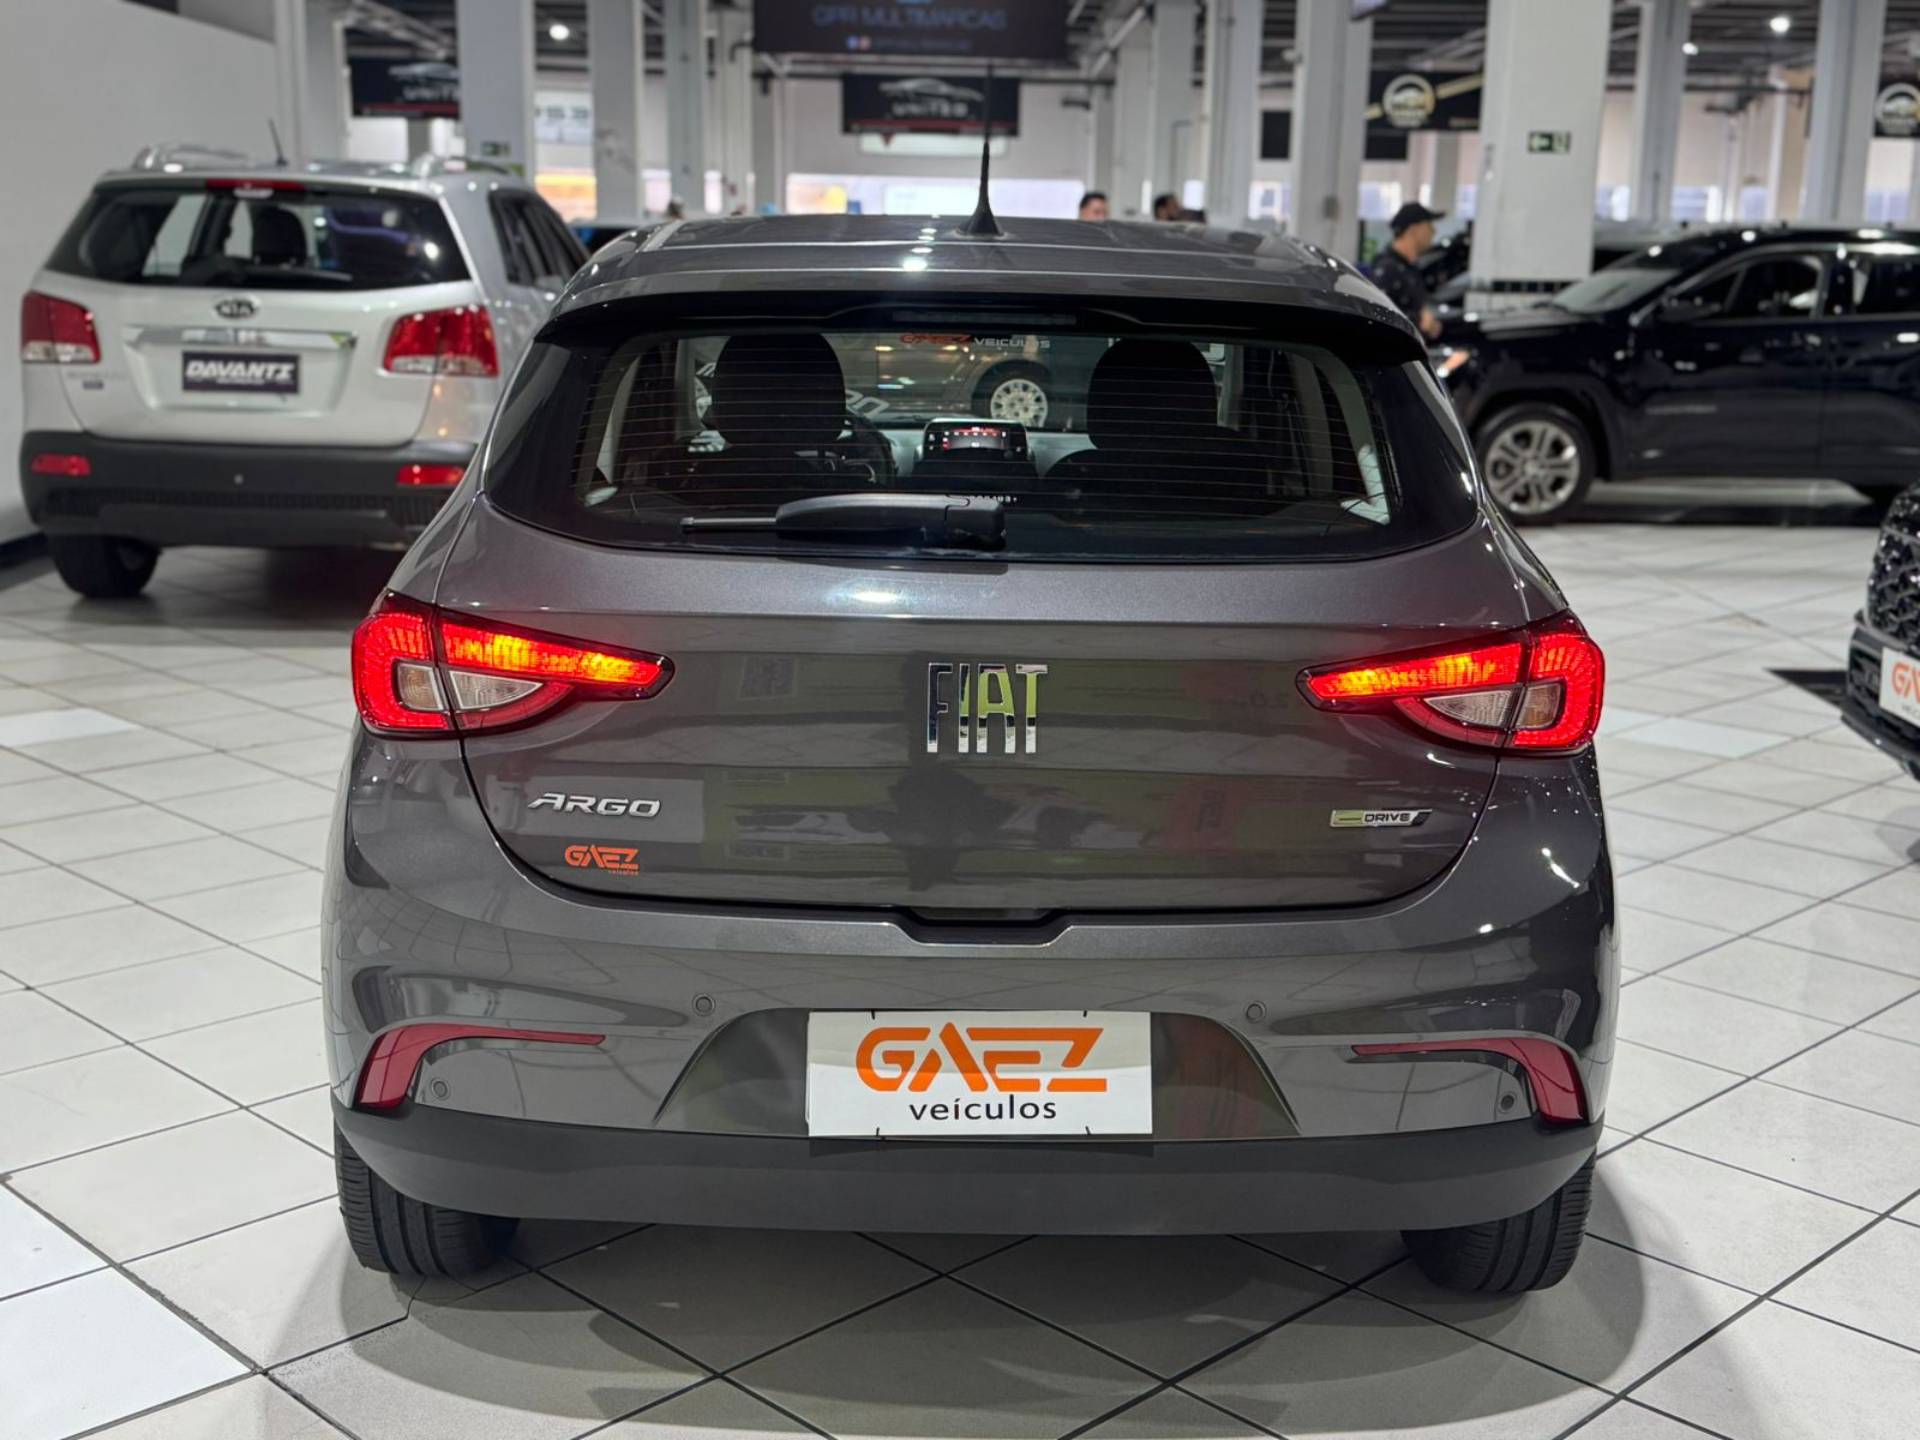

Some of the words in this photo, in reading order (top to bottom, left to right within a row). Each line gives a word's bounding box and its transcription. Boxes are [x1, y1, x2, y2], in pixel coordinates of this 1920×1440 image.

[973, 336, 1050, 348] VEICULS
[927, 662, 1048, 753] FIAT
[527, 792, 660, 817] ARGO
[1364, 812, 1411, 823] DRIVE
[564, 844, 639, 870] GAEZ
[856, 1022, 1107, 1092] GAEZ
[908, 1094, 1057, 1120] veículos
